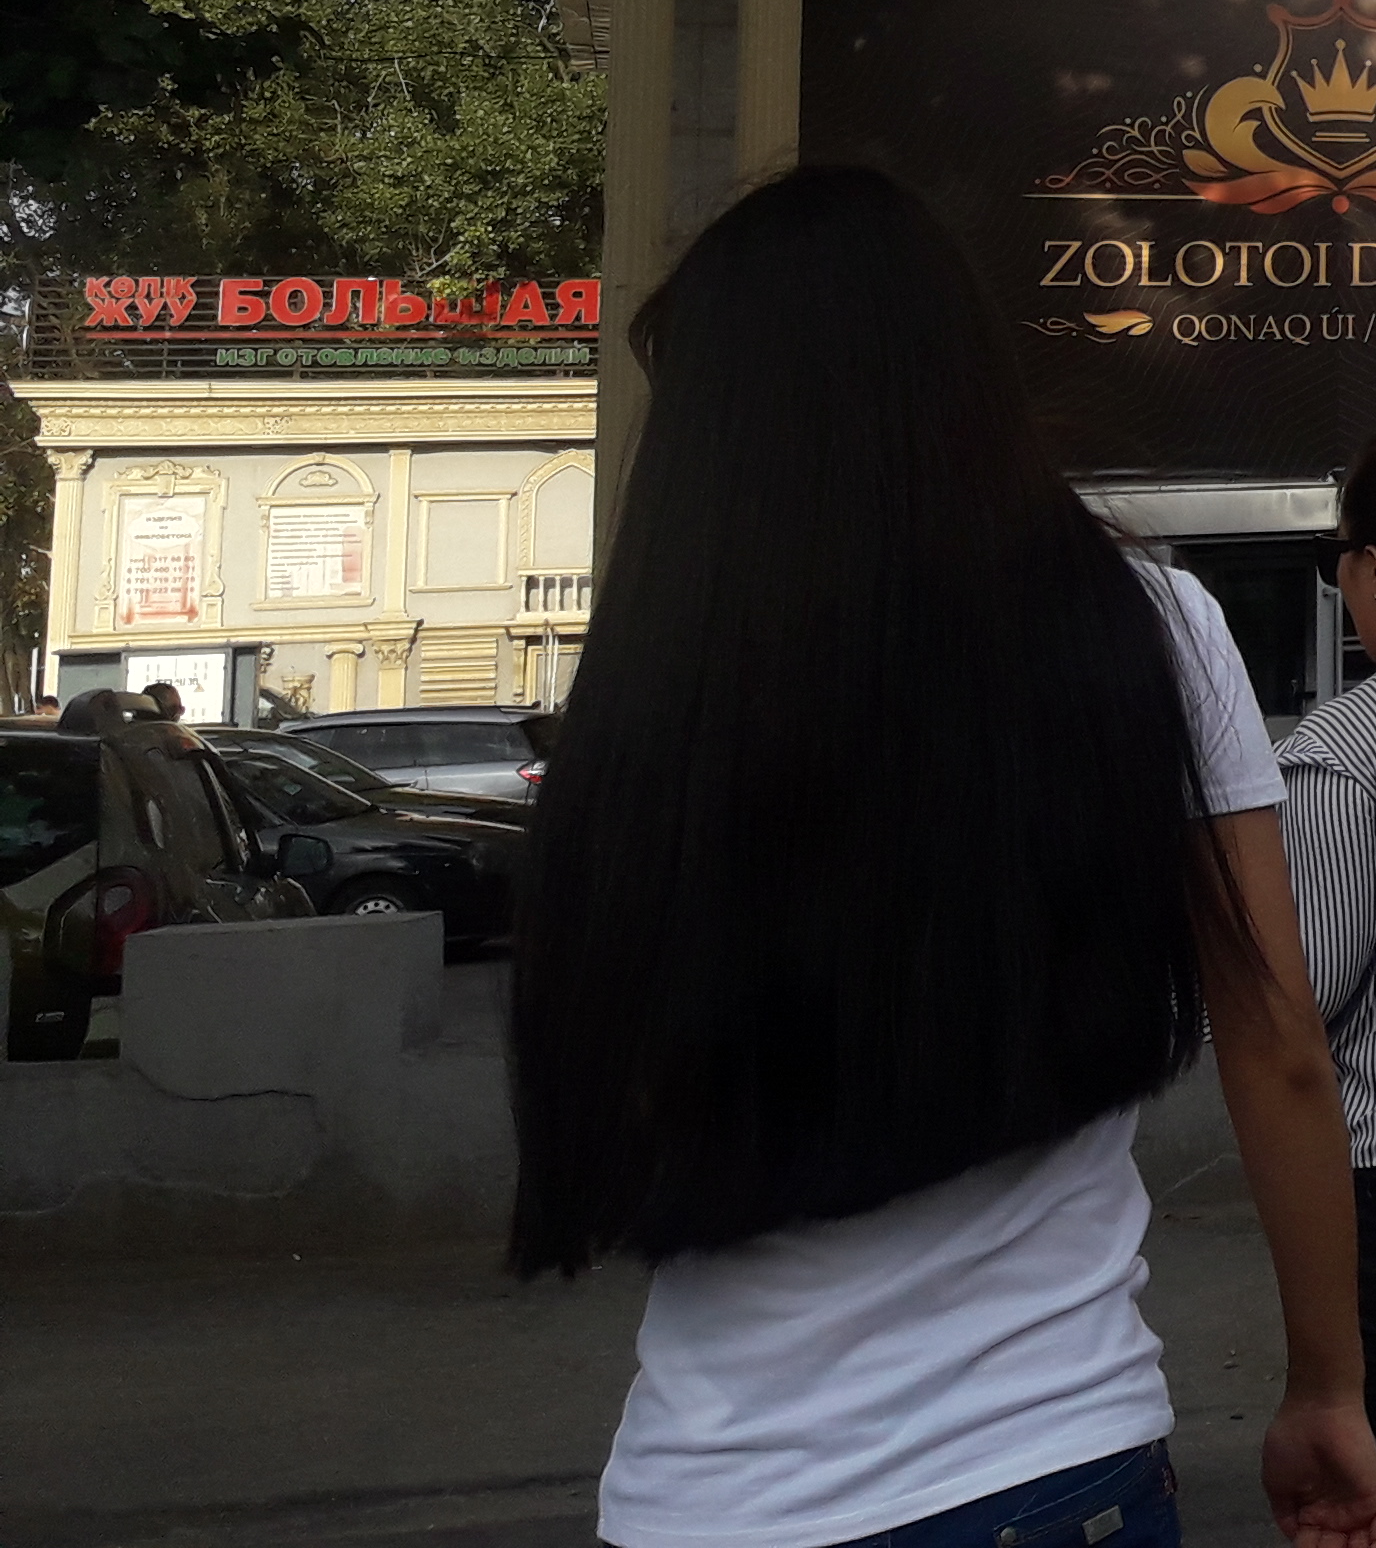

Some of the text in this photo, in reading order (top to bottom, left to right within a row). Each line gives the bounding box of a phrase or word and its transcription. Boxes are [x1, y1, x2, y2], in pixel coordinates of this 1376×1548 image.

[1039, 239, 1333, 287] ZOLOTOI
[85, 277, 198, 299] КӨЛІК
[217, 277, 601, 327] БОЛЬШАЯ
[84, 297, 198, 327] ЖУУ
[1172, 313, 1311, 347] QONAQ
[1321, 307, 1356, 341] ÚI
